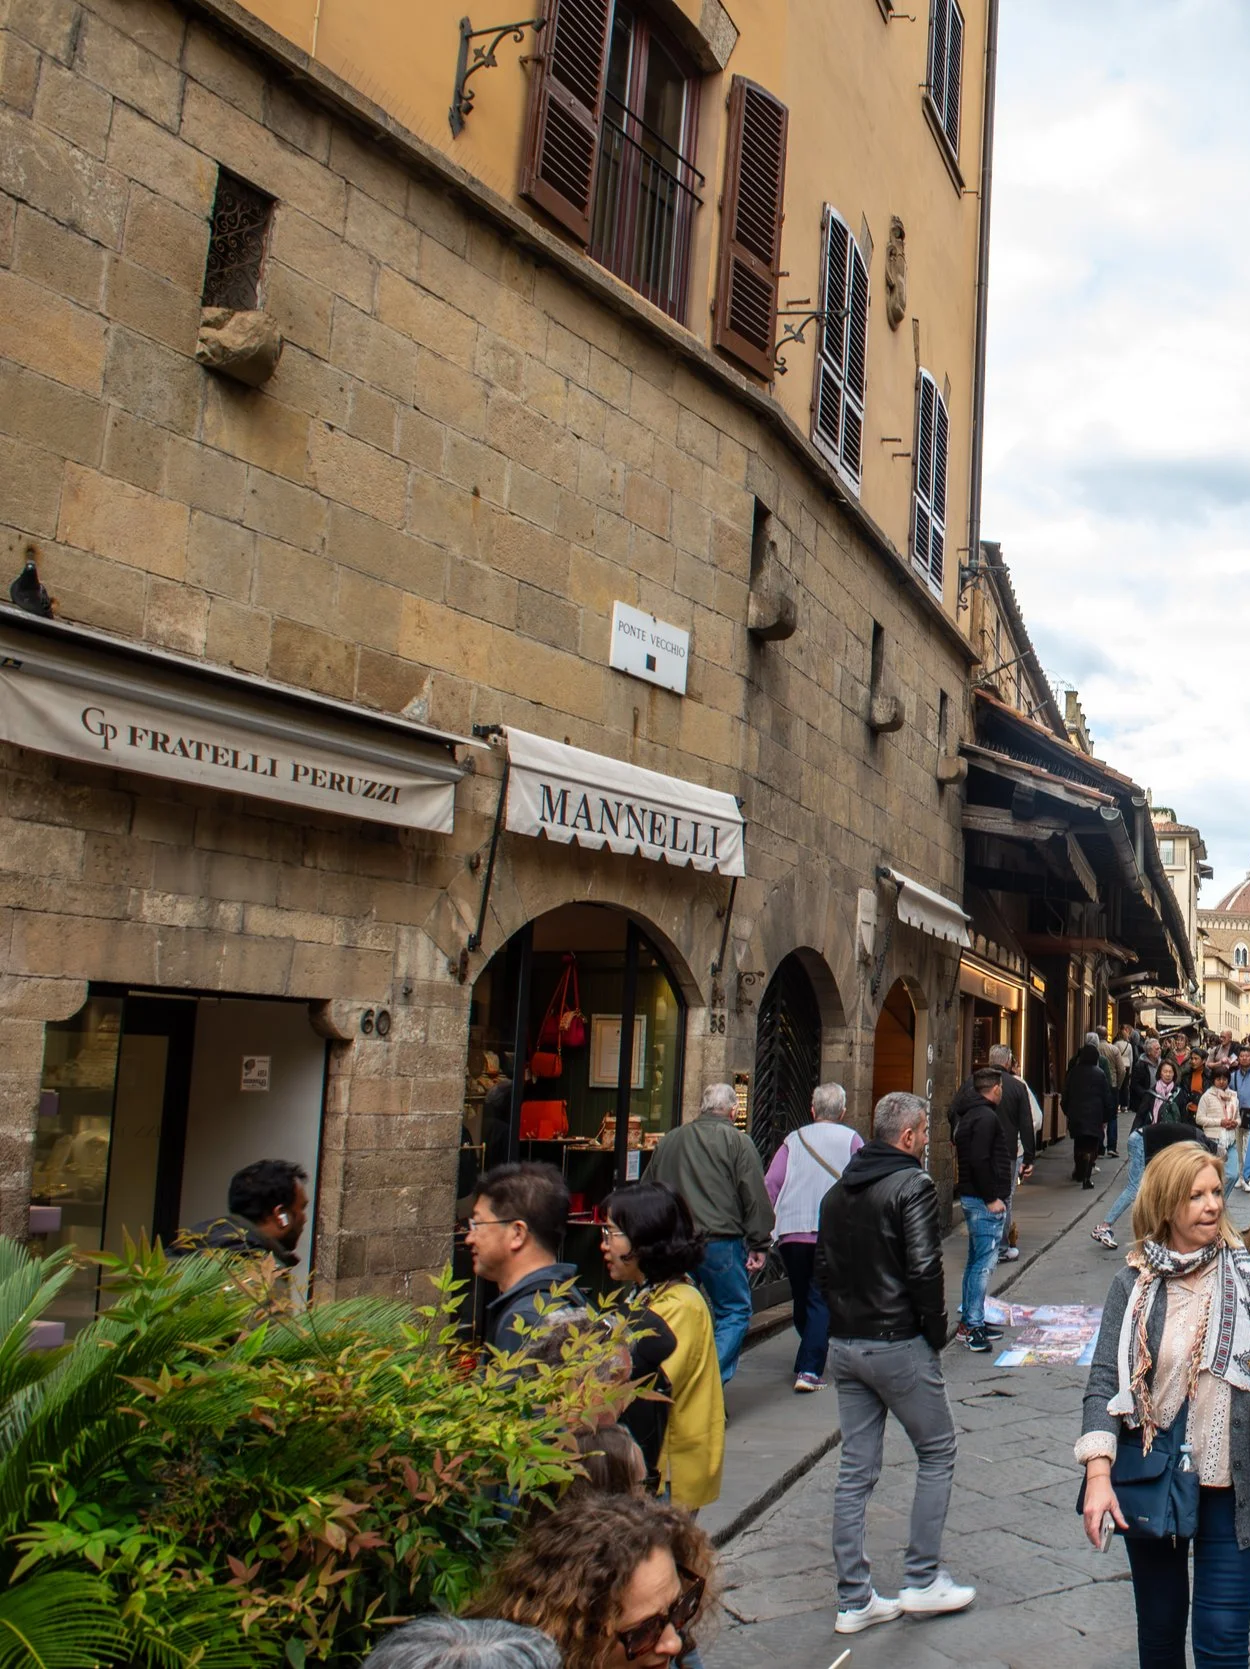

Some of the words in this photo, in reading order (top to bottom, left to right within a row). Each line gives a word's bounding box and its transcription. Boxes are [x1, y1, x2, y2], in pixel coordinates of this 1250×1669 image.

[618, 620, 647, 642] PONTE
[650, 633, 686, 658] VECCHIO
[127, 725, 279, 778] FRATELLI
[290, 763, 403, 804] PERUZZI
[539, 783, 721, 859] MANNELLI
[360, 1008, 392, 1036] 60
